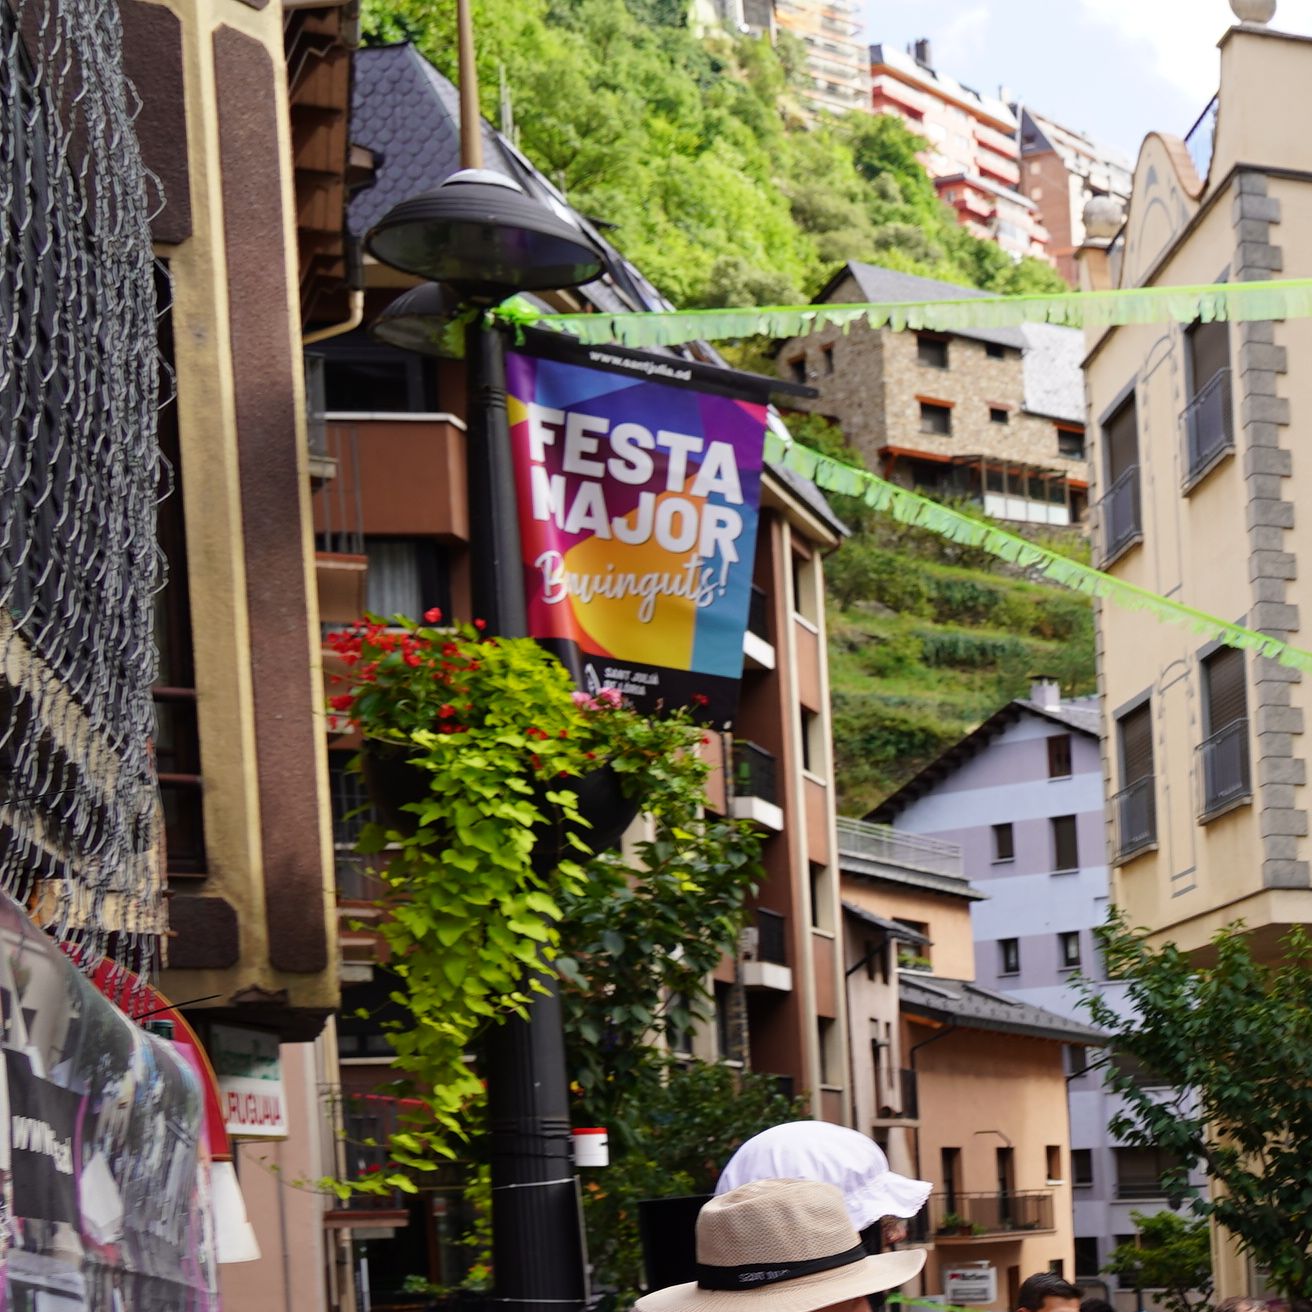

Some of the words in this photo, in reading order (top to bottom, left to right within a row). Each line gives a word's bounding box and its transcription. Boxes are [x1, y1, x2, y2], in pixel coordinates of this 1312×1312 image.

[528, 402, 743, 505] FESTA
[531, 465, 743, 562] MAJOR
[535, 550, 730, 623] Bnvinguts!
